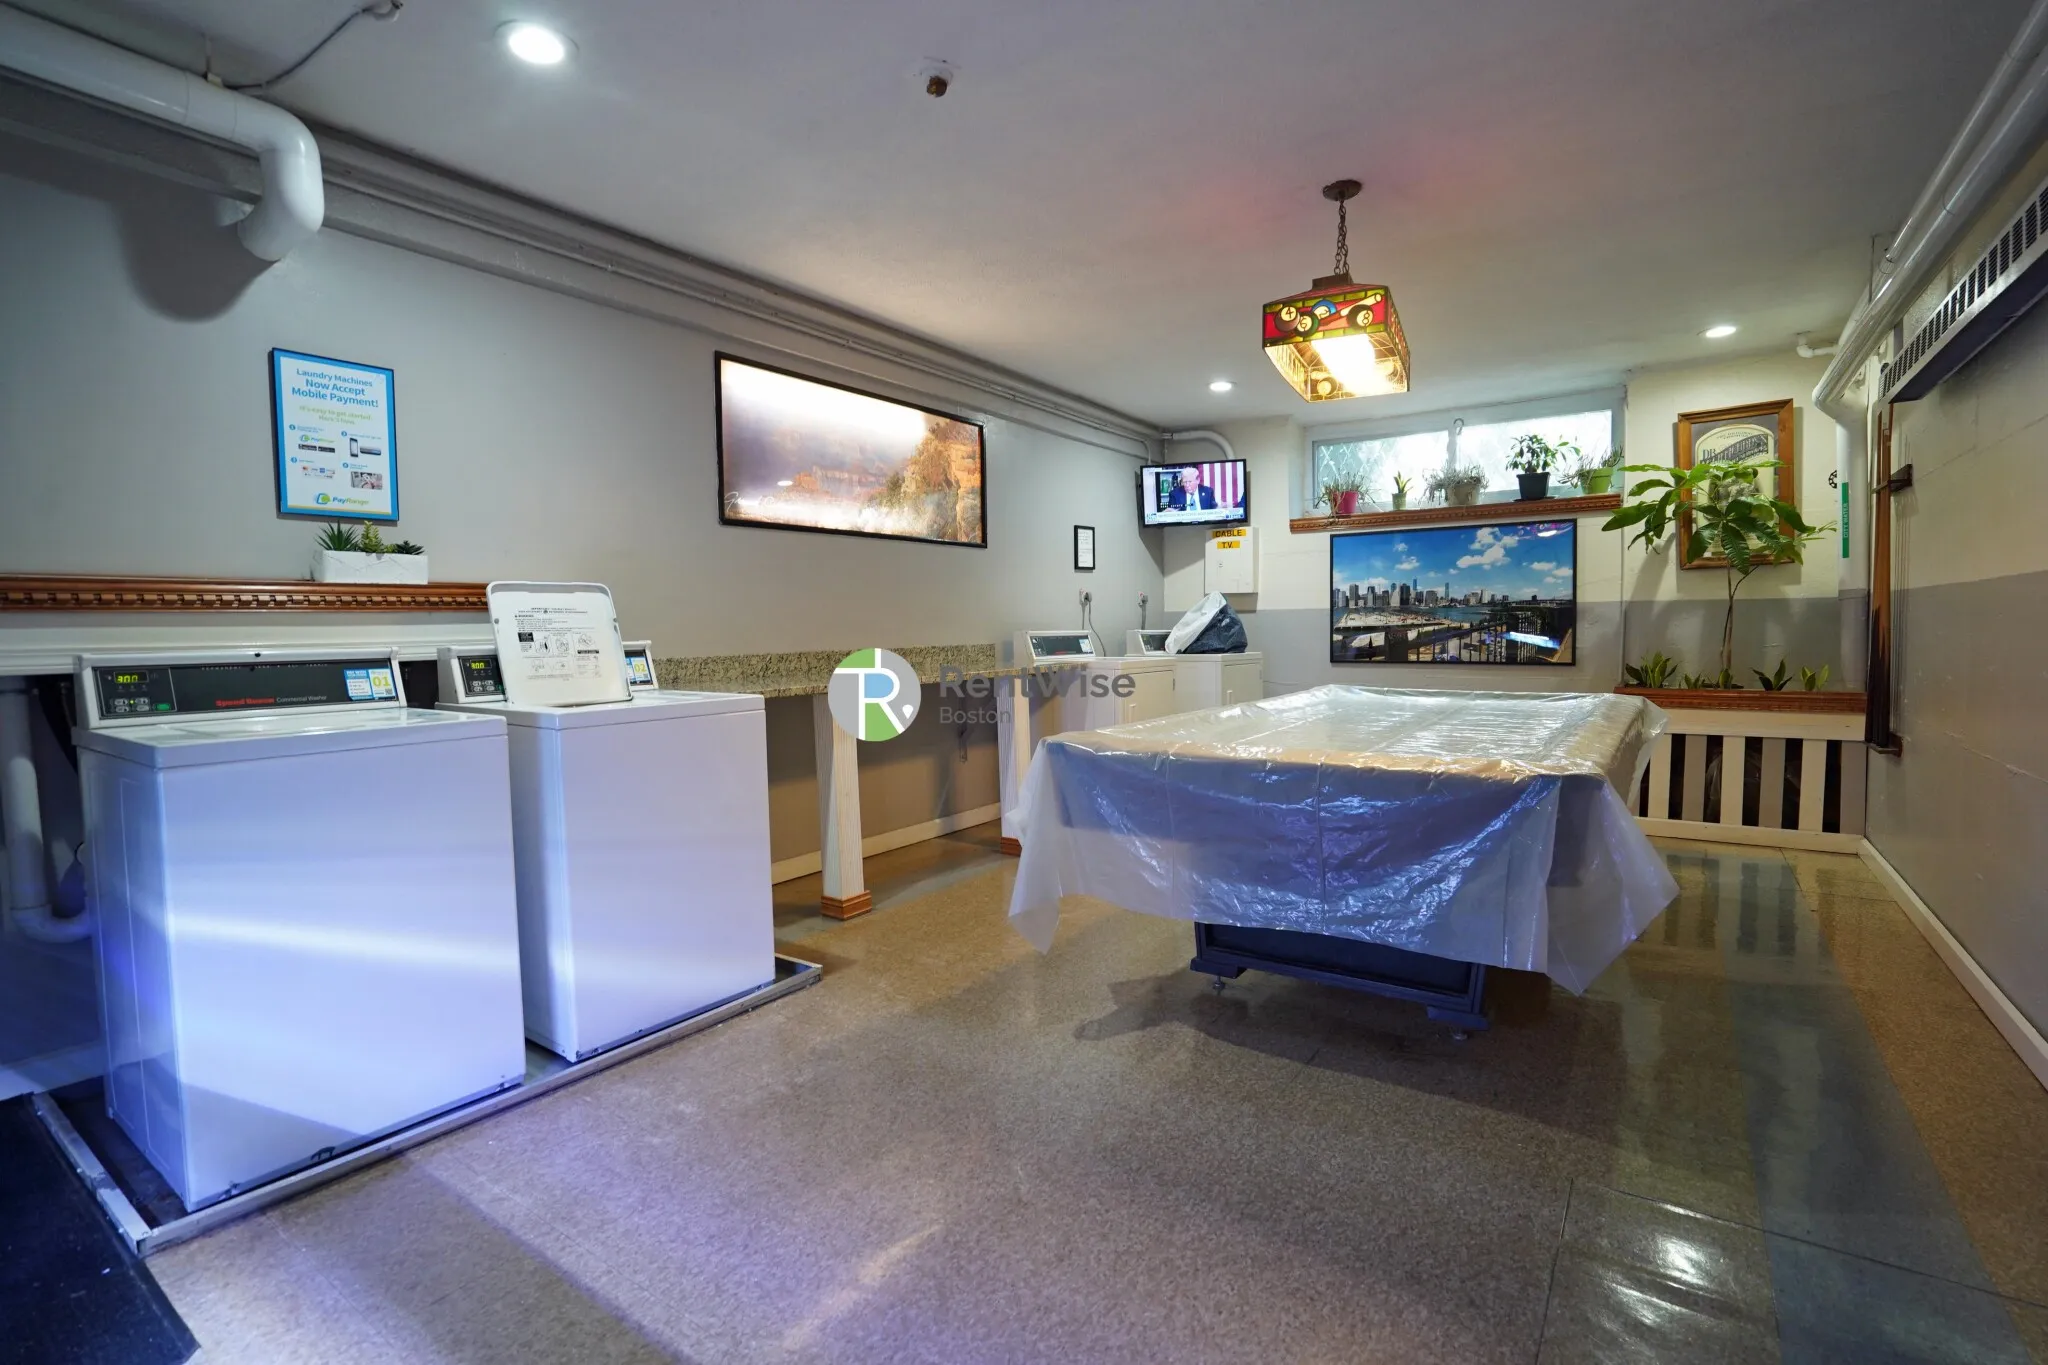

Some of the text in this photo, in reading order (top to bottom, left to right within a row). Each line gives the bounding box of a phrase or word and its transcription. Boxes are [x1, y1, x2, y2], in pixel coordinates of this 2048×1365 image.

[1285, 306, 1294, 319] 4
[1361, 312, 1370, 326] 8
[296, 368, 373, 387] Laundry Machines
[305, 378, 366, 396] Now Accept
[291, 386, 379, 408] Mobile Payment!
[1215, 529, 1243, 538] CABLE
[634, 663, 647, 673] 02
[372, 676, 391, 687] 01
